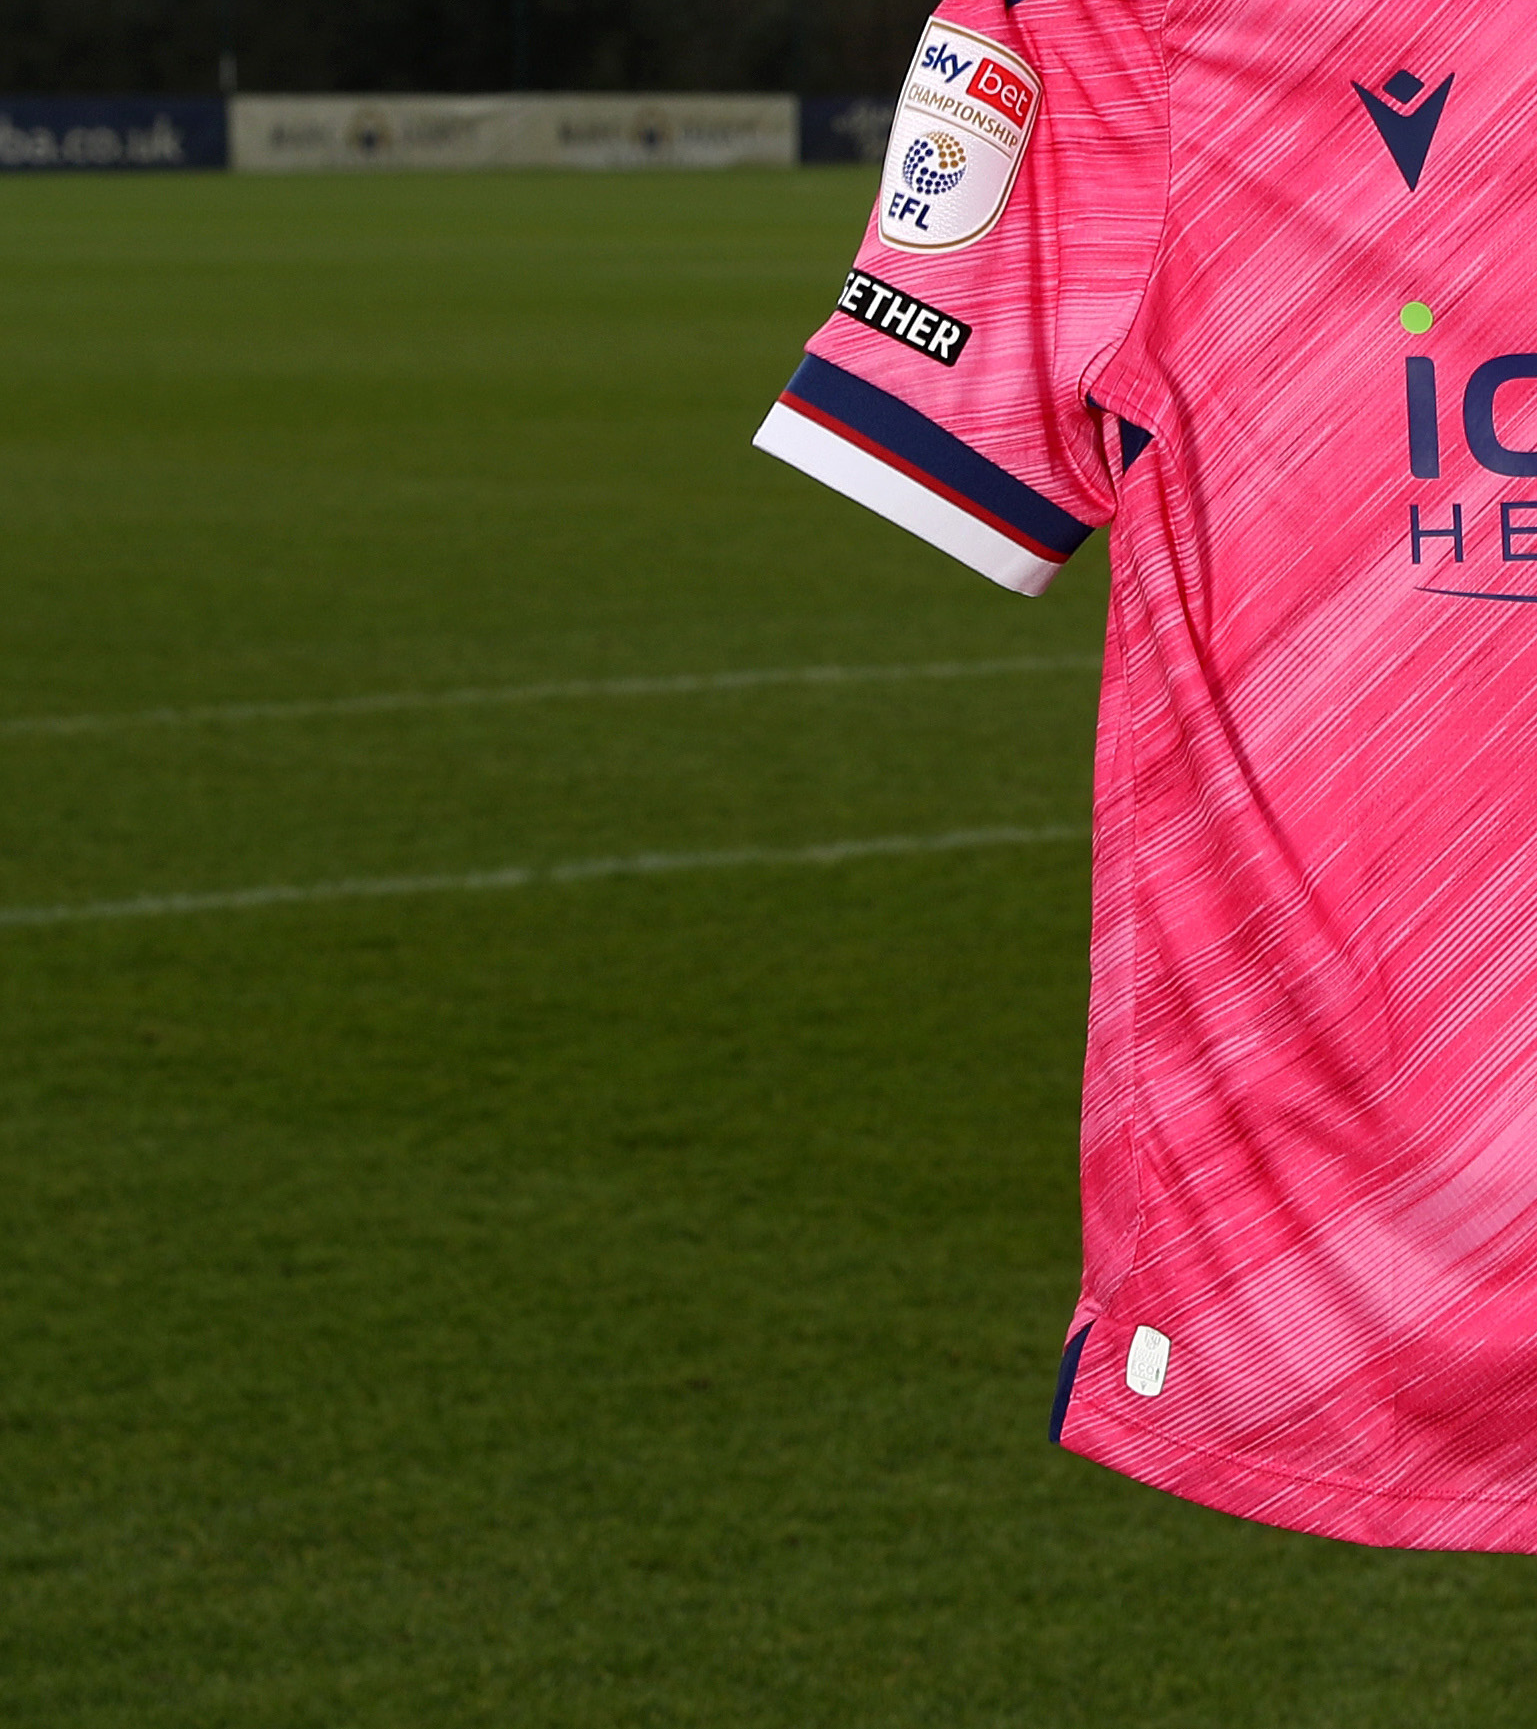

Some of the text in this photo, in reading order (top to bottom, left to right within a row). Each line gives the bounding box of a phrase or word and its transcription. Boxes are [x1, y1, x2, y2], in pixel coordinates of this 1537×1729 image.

[921, 42, 1027, 117] sky bet
[908, 83, 1018, 148] CHAMPIONSHIP
[888, 191, 932, 231] EFL
